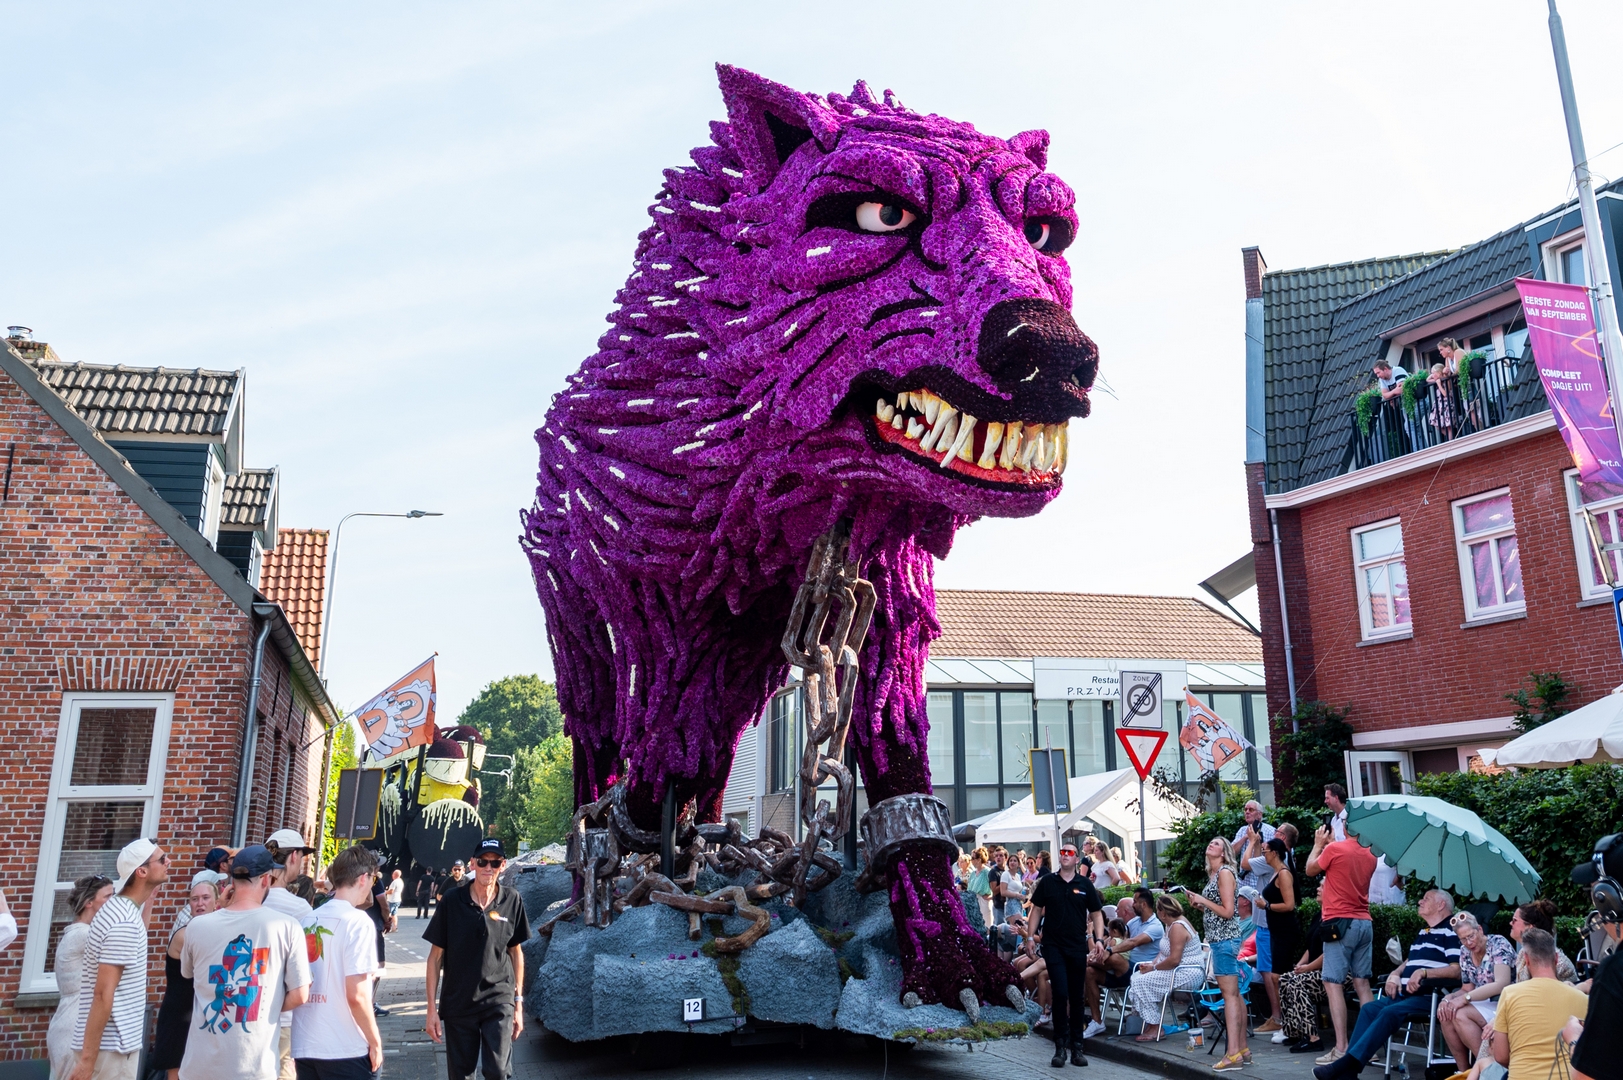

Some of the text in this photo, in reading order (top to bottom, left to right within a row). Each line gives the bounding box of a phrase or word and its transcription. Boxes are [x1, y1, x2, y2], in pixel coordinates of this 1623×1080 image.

[1524, 295, 1586, 310] EERSTE ZONDAG
[1525, 307, 1587, 321] VAN SEPTEMBER
[1541, 368, 1582, 379] COMPLEET
[1551, 380, 1593, 392] DAGJE UIT!
[1091, 675, 1120, 684] Restau
[1133, 693, 1151, 706] 30
[686, 1001, 700, 1013] 12
